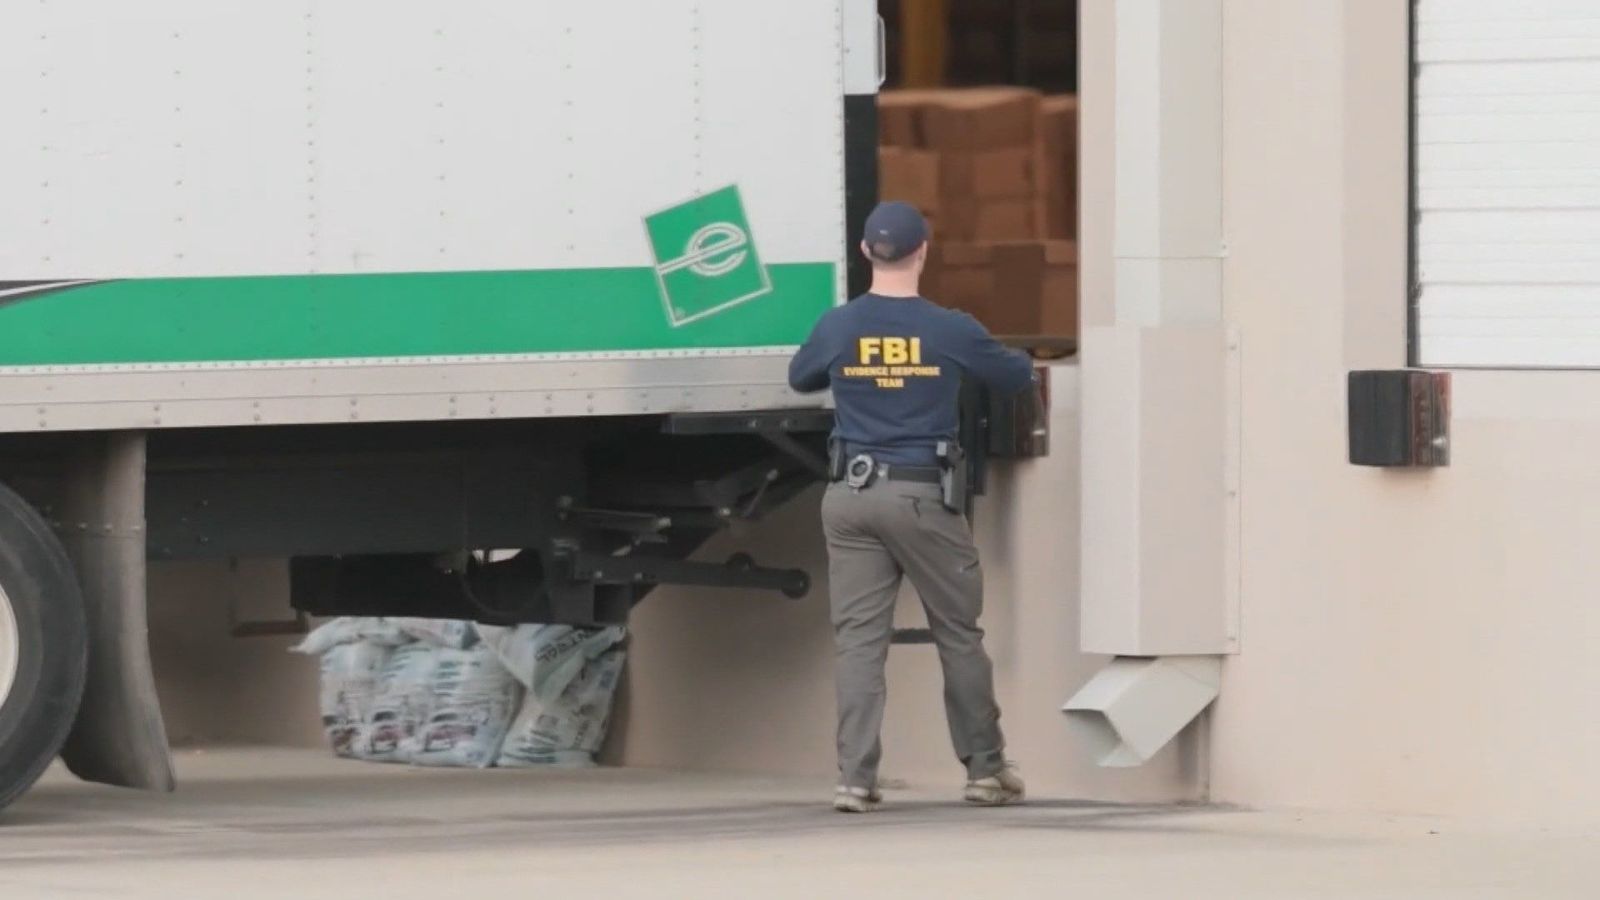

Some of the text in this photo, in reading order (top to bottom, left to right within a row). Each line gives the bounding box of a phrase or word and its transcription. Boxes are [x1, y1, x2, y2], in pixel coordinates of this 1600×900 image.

[859, 336, 921, 365] FBI
[843, 366, 941, 377] EVIDENCE RESPONSE
[875, 378, 904, 388] TEAM
